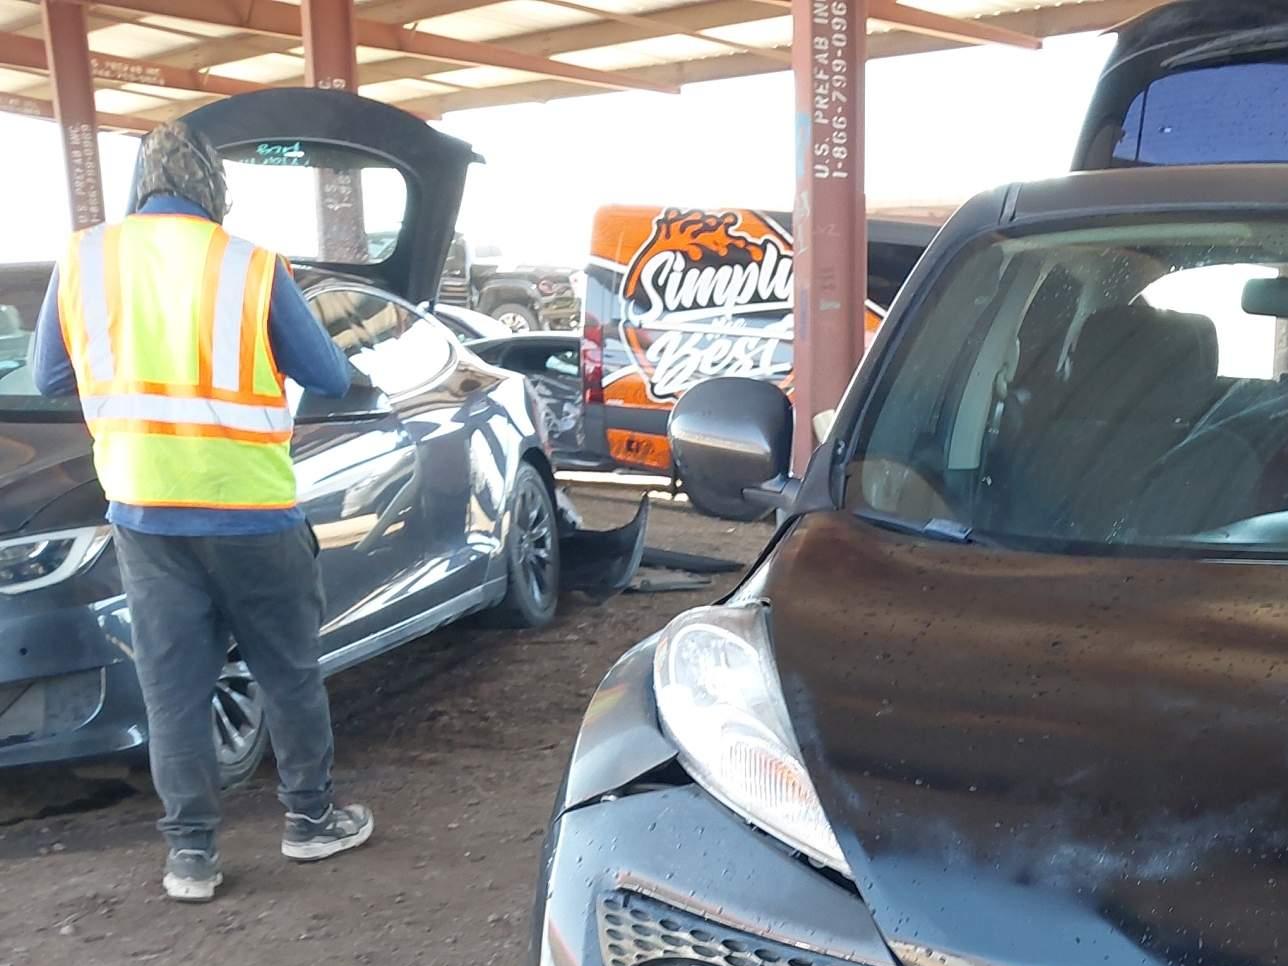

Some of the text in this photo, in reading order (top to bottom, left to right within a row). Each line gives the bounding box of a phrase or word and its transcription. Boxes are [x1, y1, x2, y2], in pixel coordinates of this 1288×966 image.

[813, 0, 830, 179] U.S. PREFAB IN
